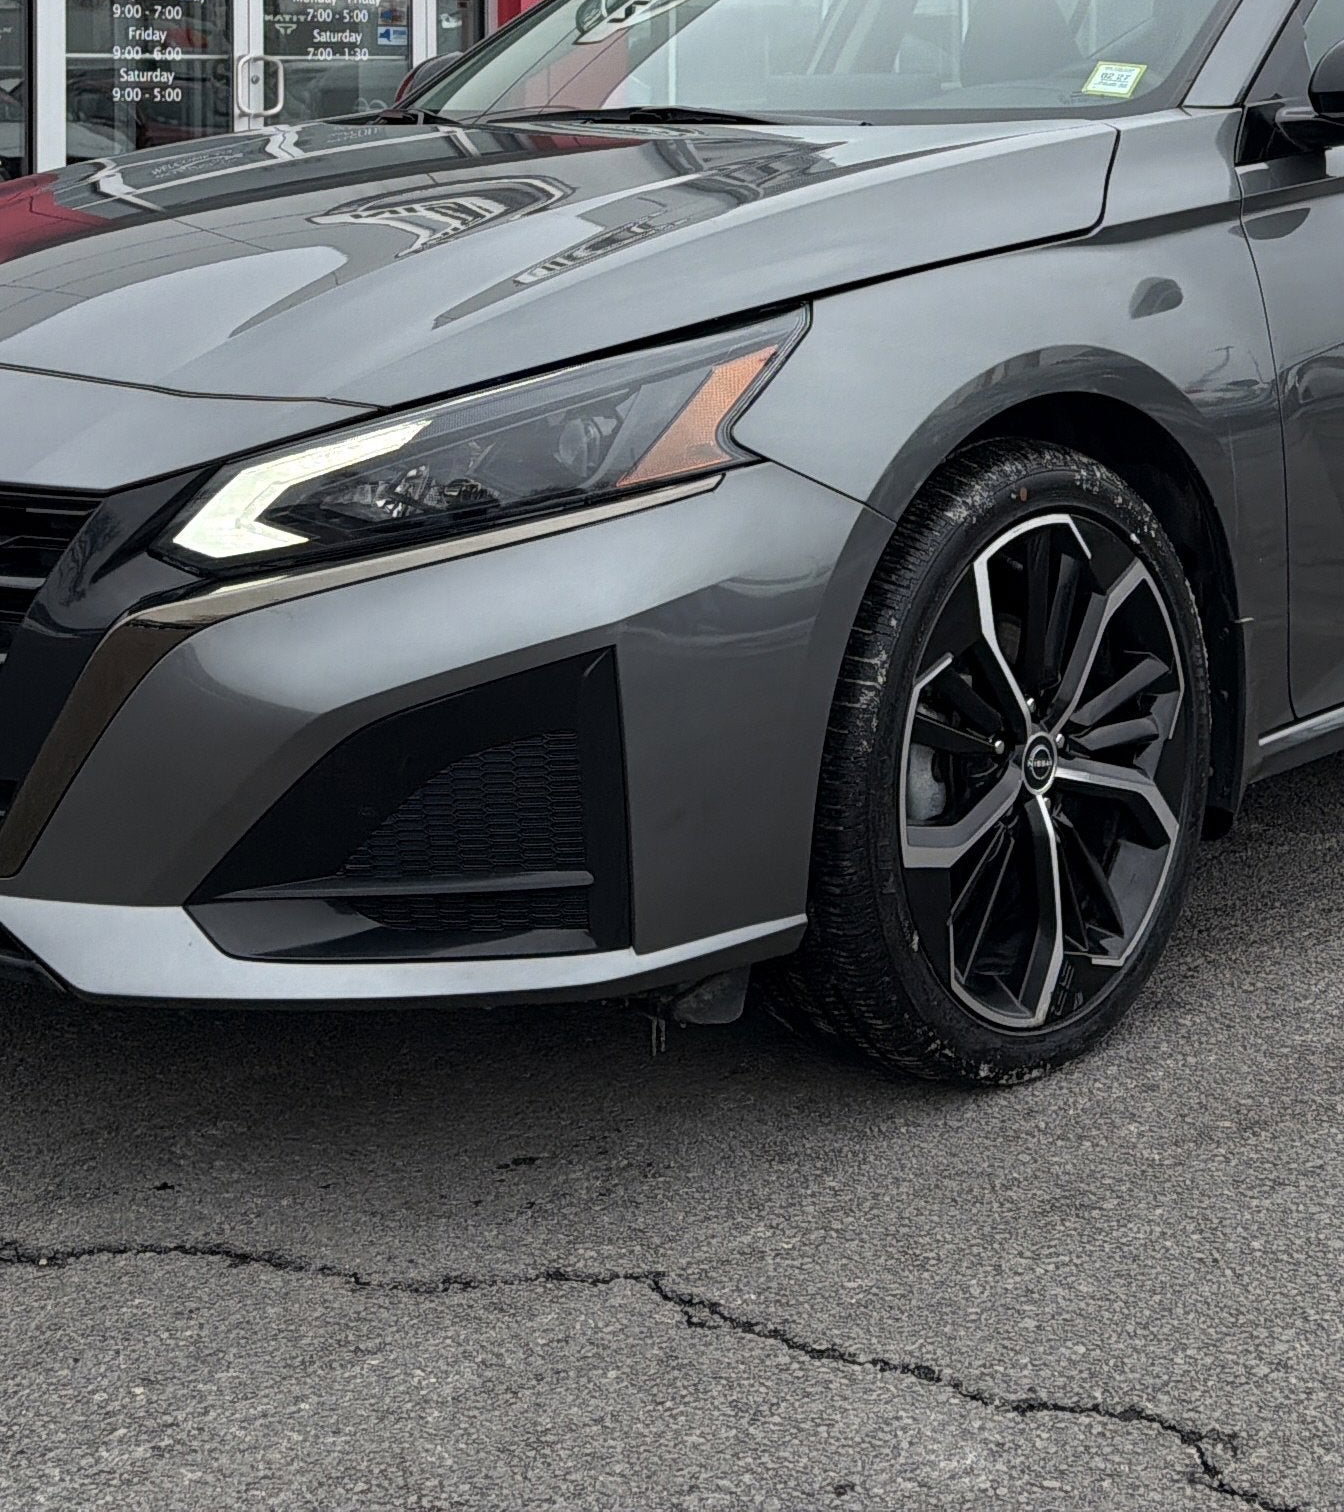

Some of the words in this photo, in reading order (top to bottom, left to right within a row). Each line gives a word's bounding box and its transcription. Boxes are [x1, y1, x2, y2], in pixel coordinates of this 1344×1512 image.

[112, 4, 142, 18] 9:00
[153, 5, 182, 19] 7:00
[306, 8, 333, 22] 7:00
[342, 9, 369, 23] 5:00
[128, 27, 167, 43] Friday
[312, 29, 363, 45] Saturday
[112, 46, 142, 60] 9:00
[153, 46, 182, 60] 6:00
[306, 48, 333, 61] 7:00
[343, 48, 369, 61] 1:30
[119, 68, 175, 85] Saturday
[112, 88, 142, 102] 9:00
[153, 88, 182, 102] 5:00
